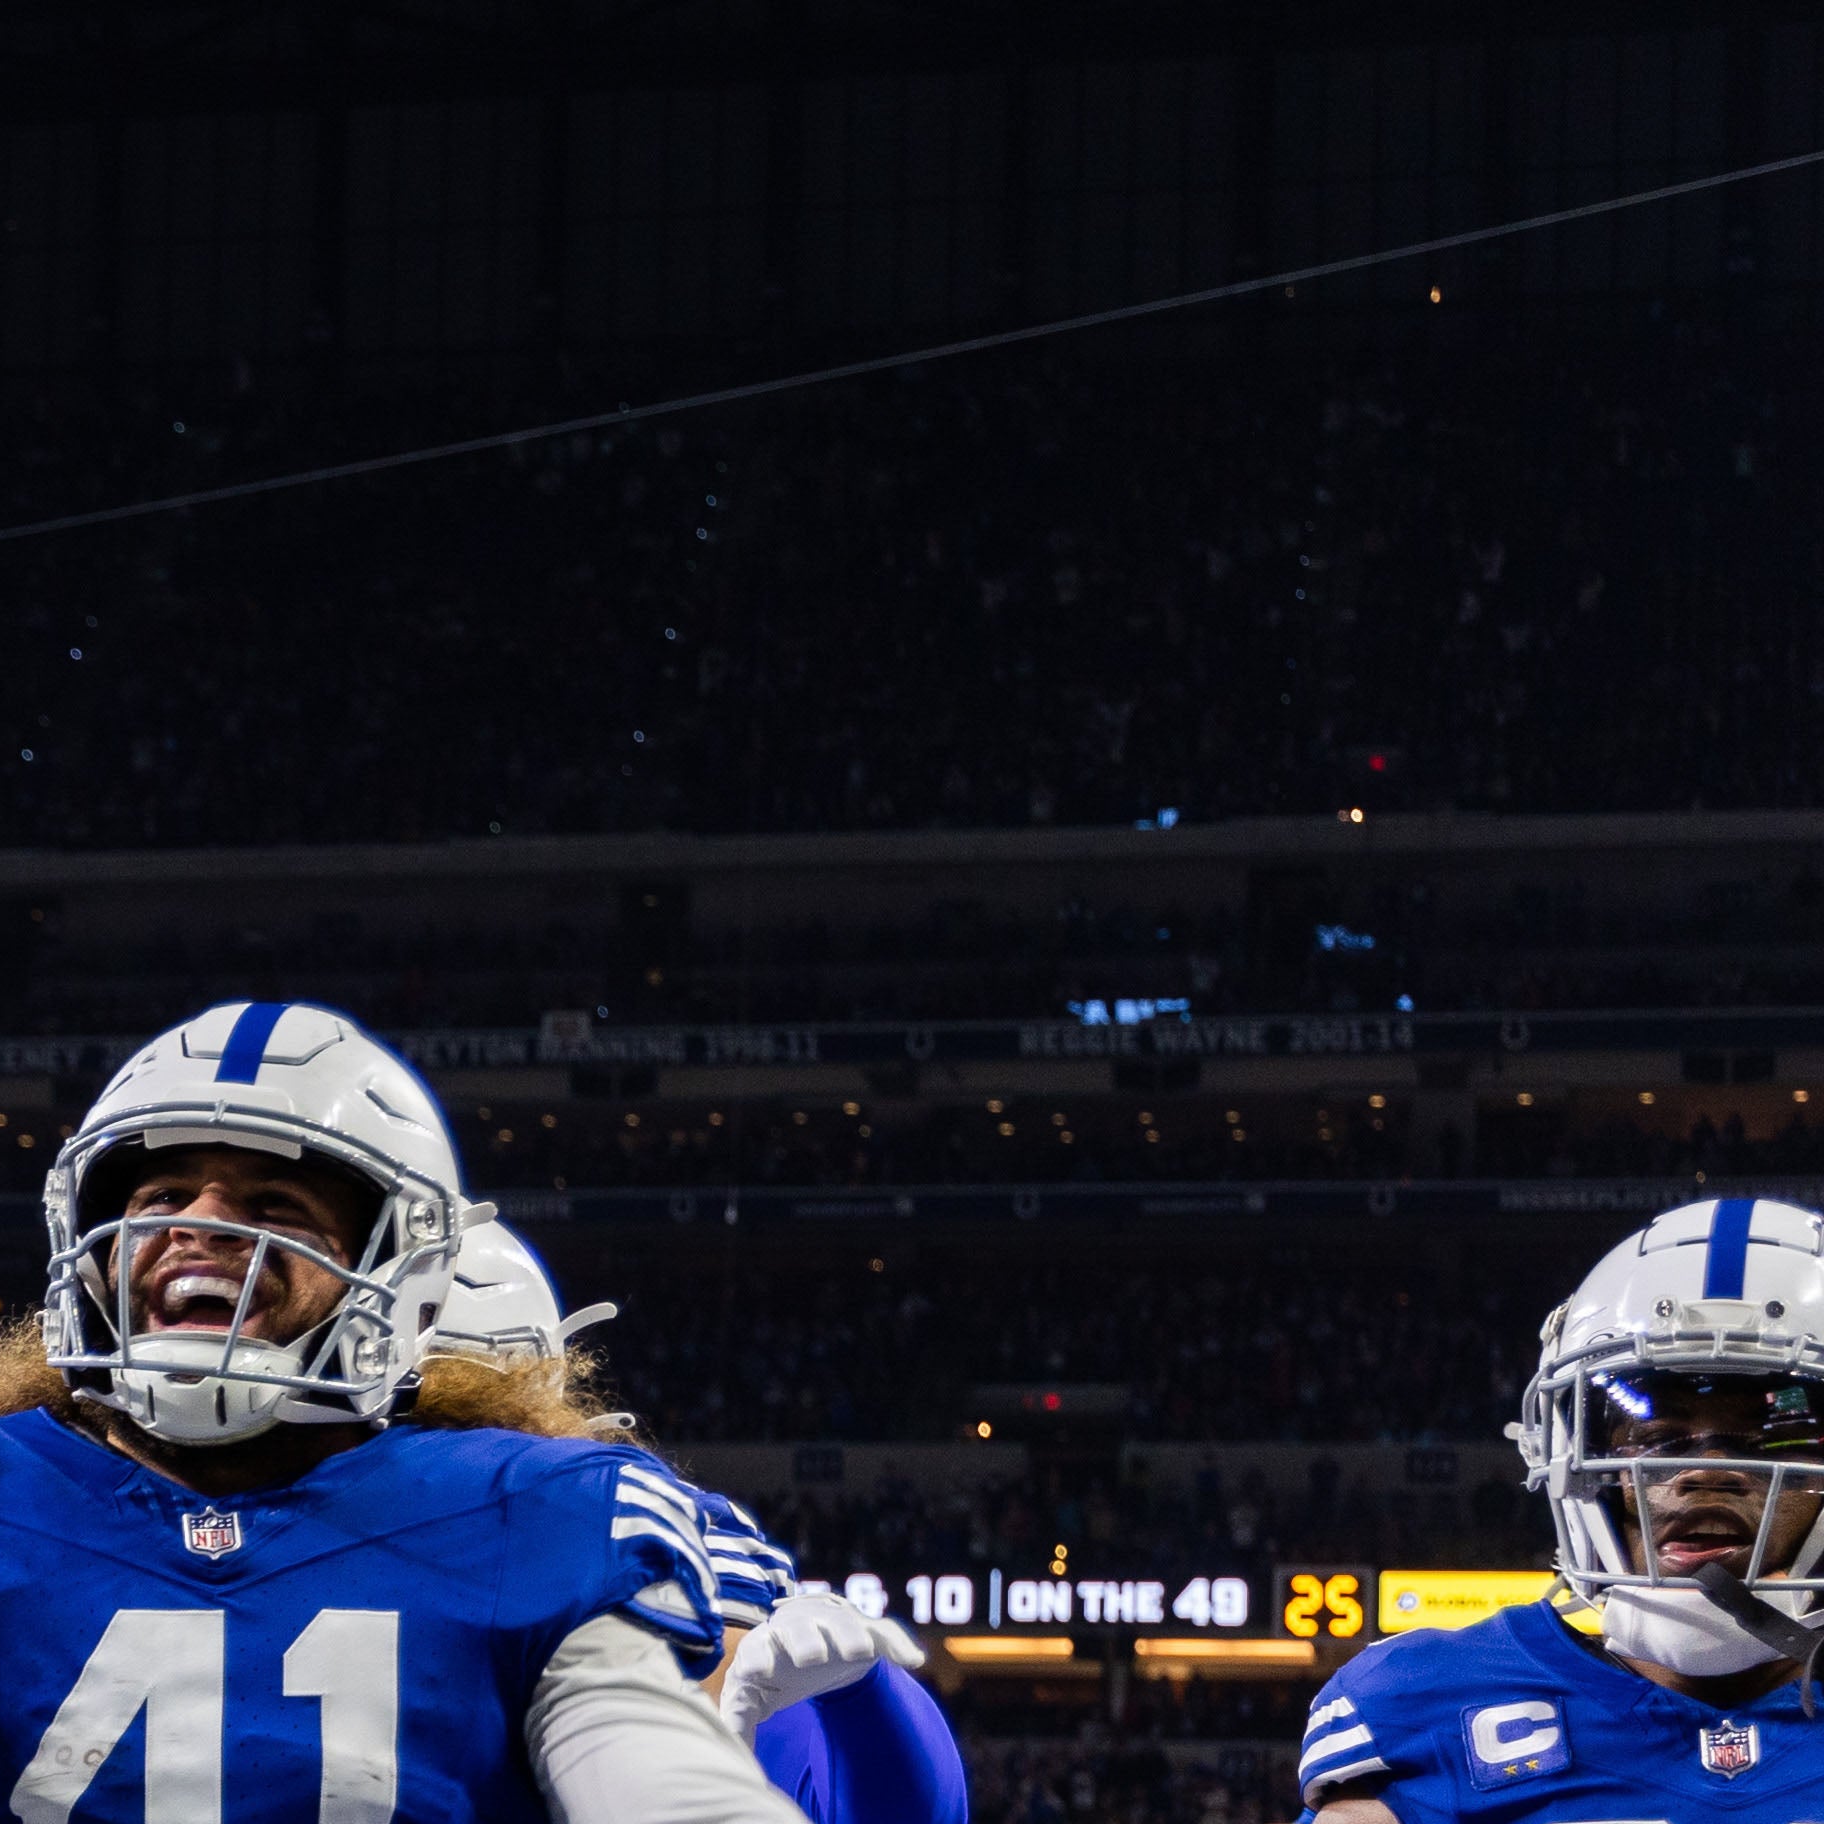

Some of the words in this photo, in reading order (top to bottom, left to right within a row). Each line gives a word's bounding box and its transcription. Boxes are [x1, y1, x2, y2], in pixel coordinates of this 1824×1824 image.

[906, 1574, 974, 1626] 10
[1006, 1579, 1073, 1624] ON
[1076, 1580, 1165, 1625] THE
[1283, 1572, 1364, 1639] 25
[1471, 1701, 1561, 1764] C
